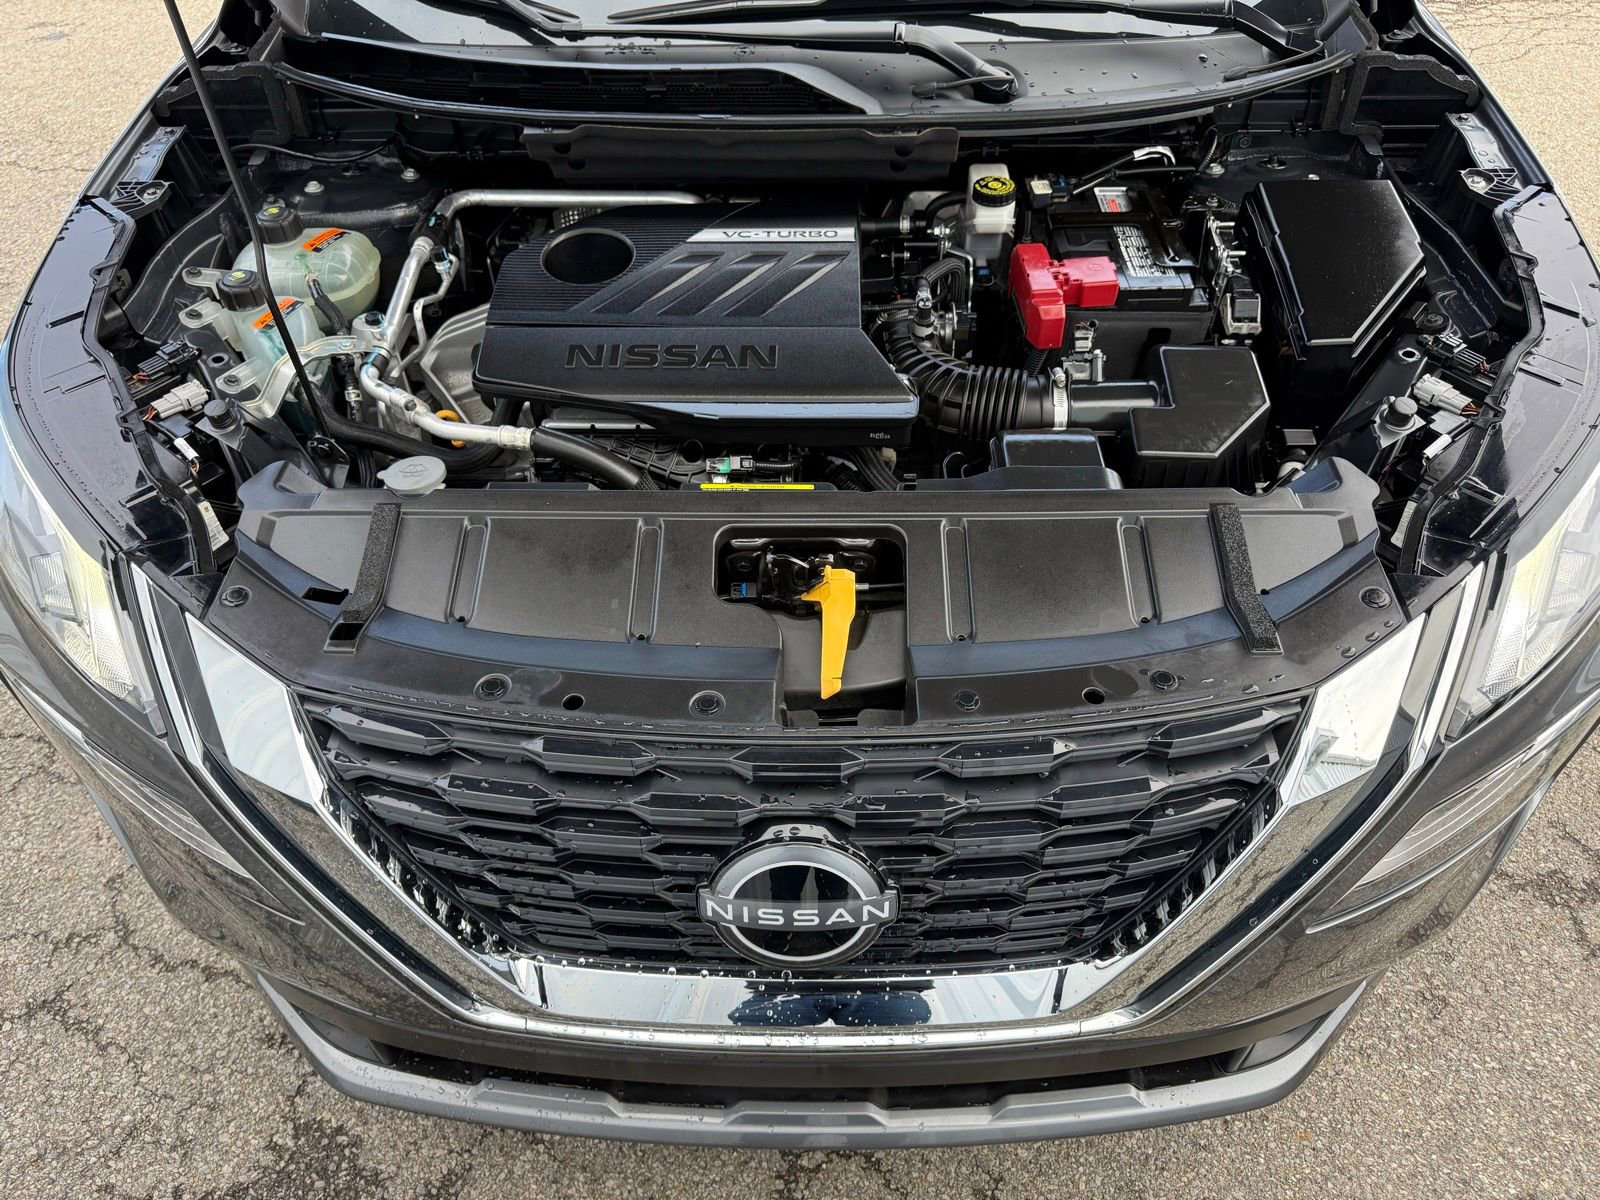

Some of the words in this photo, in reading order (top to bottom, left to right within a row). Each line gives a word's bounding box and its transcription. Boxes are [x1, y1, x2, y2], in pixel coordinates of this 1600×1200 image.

[722, 230, 838, 239] VC-TURBO
[564, 343, 779, 369] NISSAN
[705, 899, 890, 926] NISSAN
